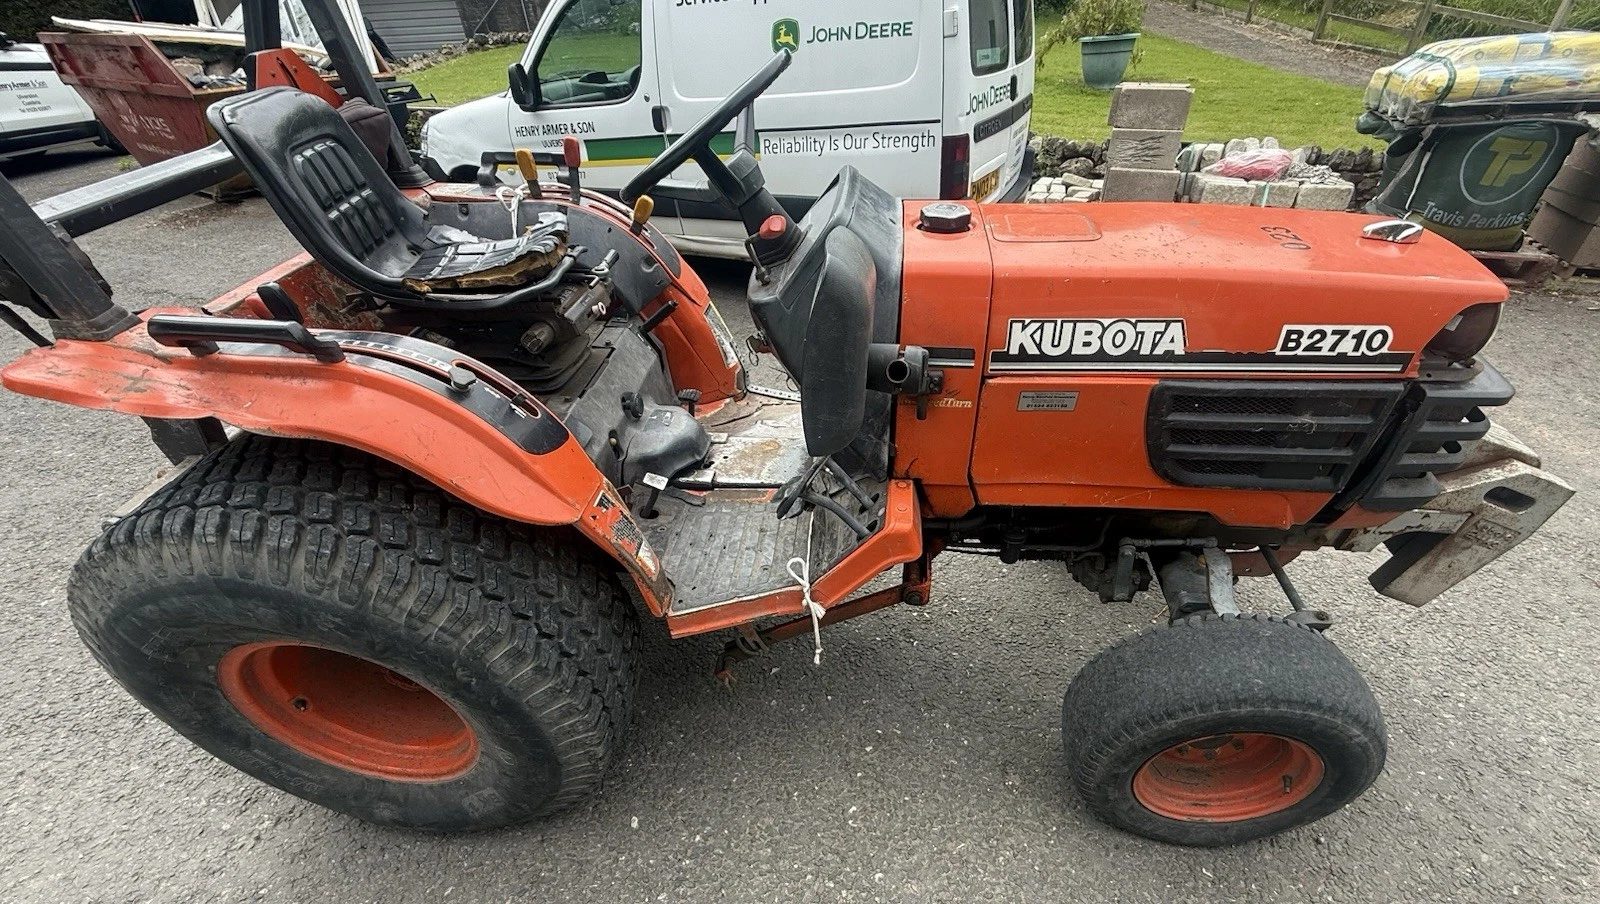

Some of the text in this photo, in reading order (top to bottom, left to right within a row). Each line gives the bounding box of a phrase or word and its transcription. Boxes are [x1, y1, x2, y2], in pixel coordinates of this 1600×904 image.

[515, 121, 596, 137] HENRY ARMER & SON
[541, 139, 564, 149] ULVERS
[763, 129, 936, 157] Reliability Is Our Strength
[1422, 201, 1464, 228] Travis
[1008, 318, 1187, 357] KUBOTA
[1279, 328, 1390, 353] B2710
